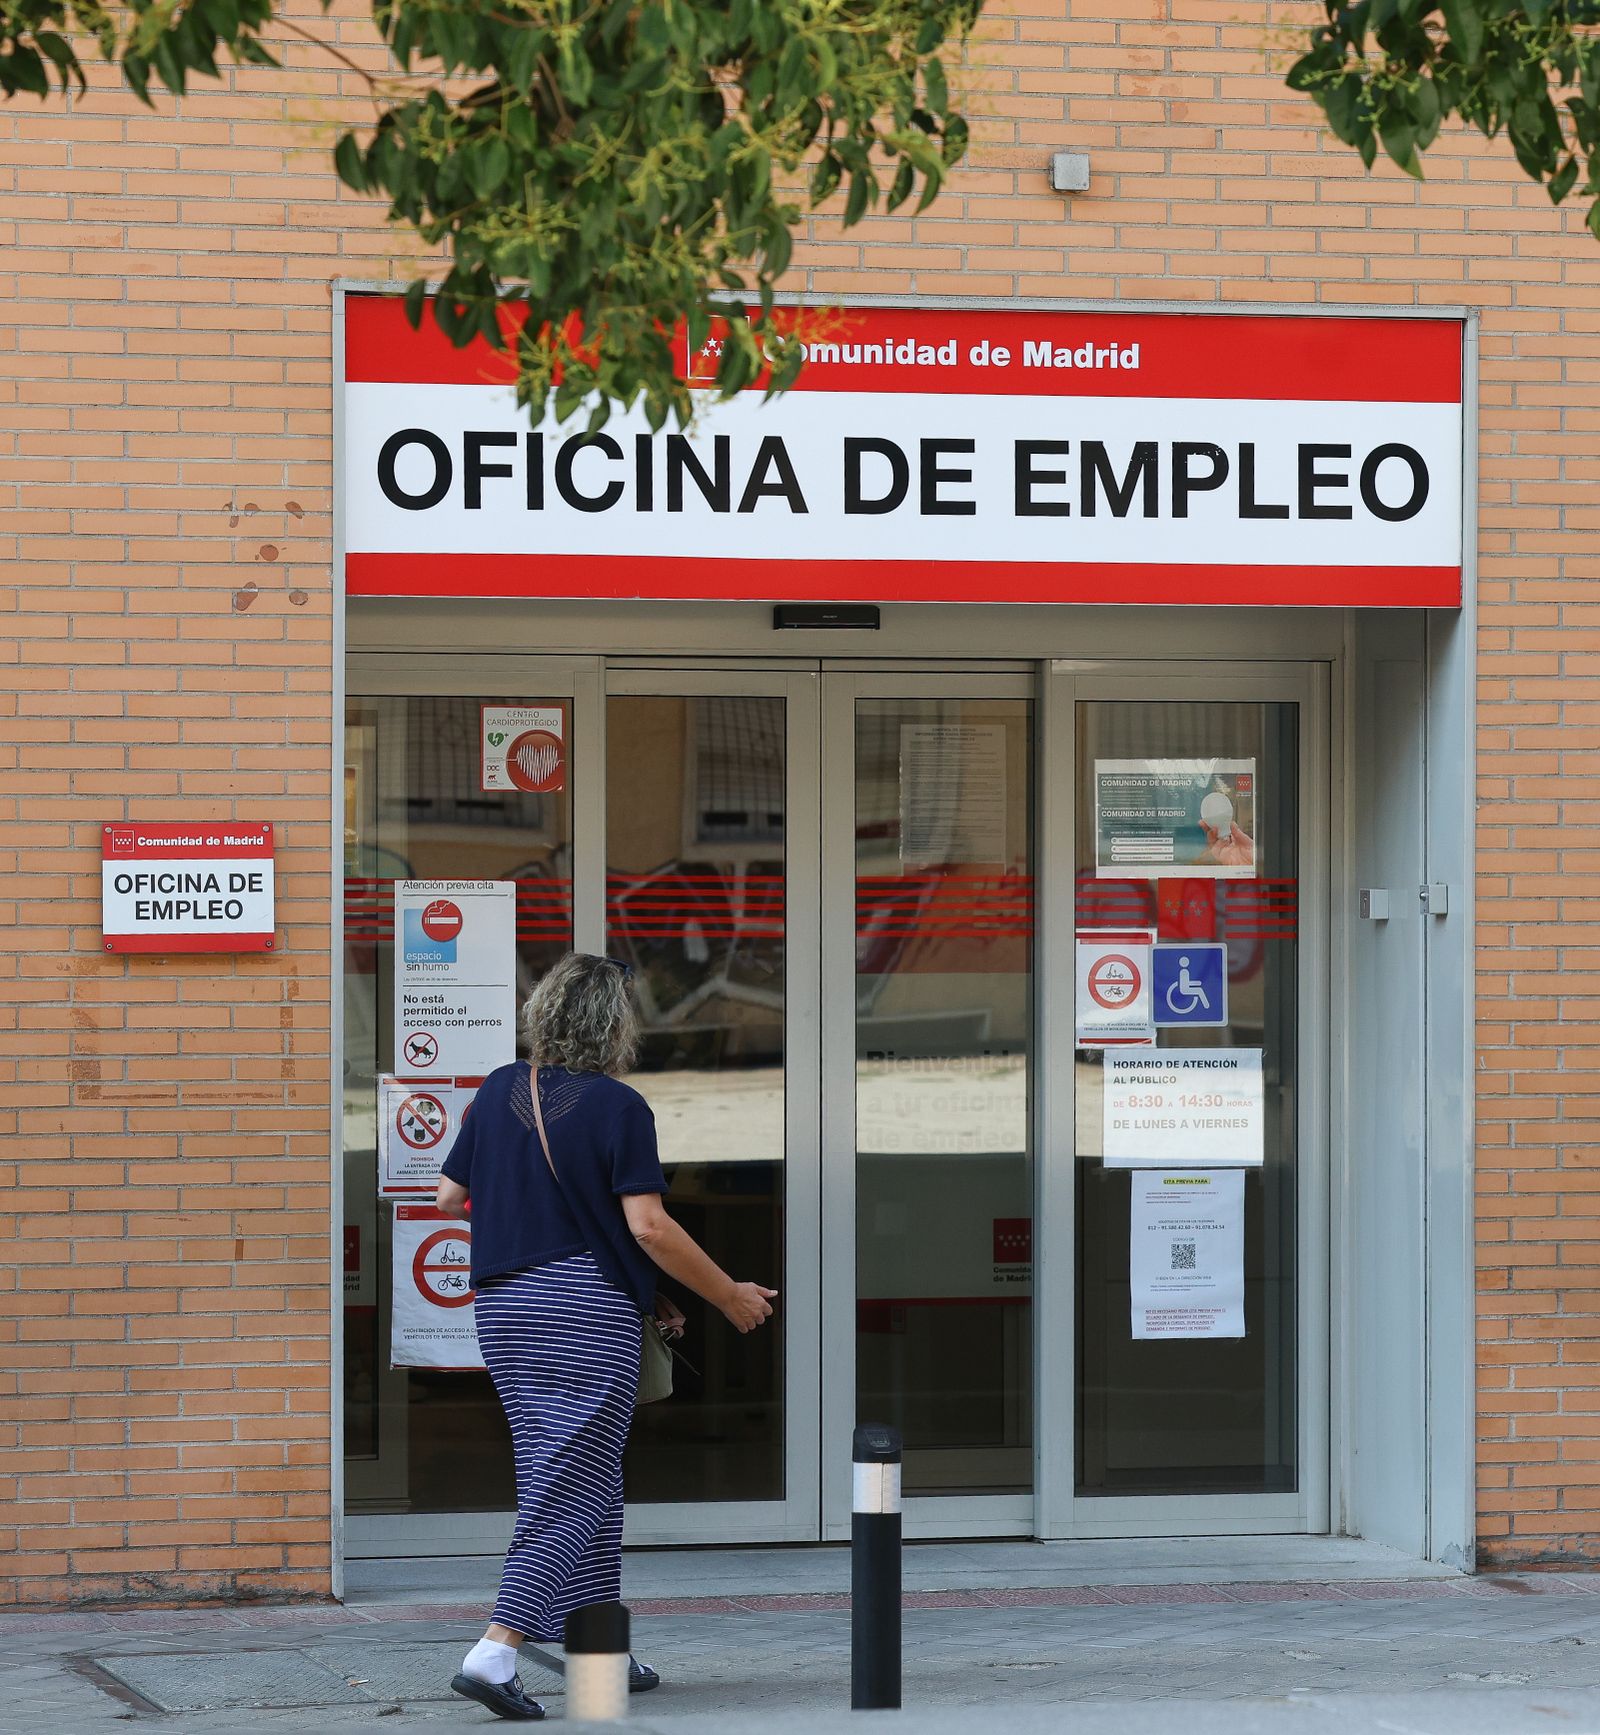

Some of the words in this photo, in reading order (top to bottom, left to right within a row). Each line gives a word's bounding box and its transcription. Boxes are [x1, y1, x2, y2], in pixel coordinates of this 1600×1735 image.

[969, 340, 1011, 367] de
[1023, 340, 1140, 370] Madrid
[377, 428, 810, 514] OFICINA
[843, 436, 978, 516] DE
[1014, 439, 1430, 523] EMPLEO
[506, 710, 540, 718] CENTRO
[486, 719, 559, 727] CARDIOPROTEGIDO
[1101, 779, 1147, 787] COMUNIDAD
[1149, 779, 1160, 787] DE
[1161, 779, 1192, 787] MADRID
[137, 836, 203, 846] Comunidad
[206, 836, 221, 846] de
[223, 835, 264, 846] Madrid
[114, 873, 221, 894] OFICINA
[229, 872, 264, 893] DE
[402, 880, 444, 890] Atención
[446, 881, 475, 893] previa
[477, 880, 494, 890] cita
[135, 899, 244, 921] EMPLEO
[406, 951, 442, 963] espacio
[406, 963, 421, 972] sin
[422, 963, 450, 972] humo
[403, 994, 418, 1004] No
[421, 993, 445, 1004] está
[403, 1005, 455, 1017] permitido
[457, 1005, 467, 1015] el
[403, 1019, 442, 1028] acceso
[444, 1019, 465, 1028] con
[467, 1018, 502, 1029] perros
[1113, 1060, 1163, 1069] HORARIO
[1166, 1060, 1180, 1069] DE
[1182, 1058, 1238, 1069] ATENCIÓN
[1113, 1076, 1127, 1085] AL
[1129, 1073, 1177, 1085] PÚBLICO
[1113, 1100, 1125, 1108] DE
[1128, 1095, 1164, 1108] 8:30
[1178, 1094, 1224, 1108] 14:30
[1227, 1099, 1254, 1107] HORAS
[1113, 1119, 1130, 1129] DE
[1134, 1119, 1177, 1129] LUNES
[1180, 1119, 1189, 1129] A
[1192, 1118, 1249, 1129] VIERNES
